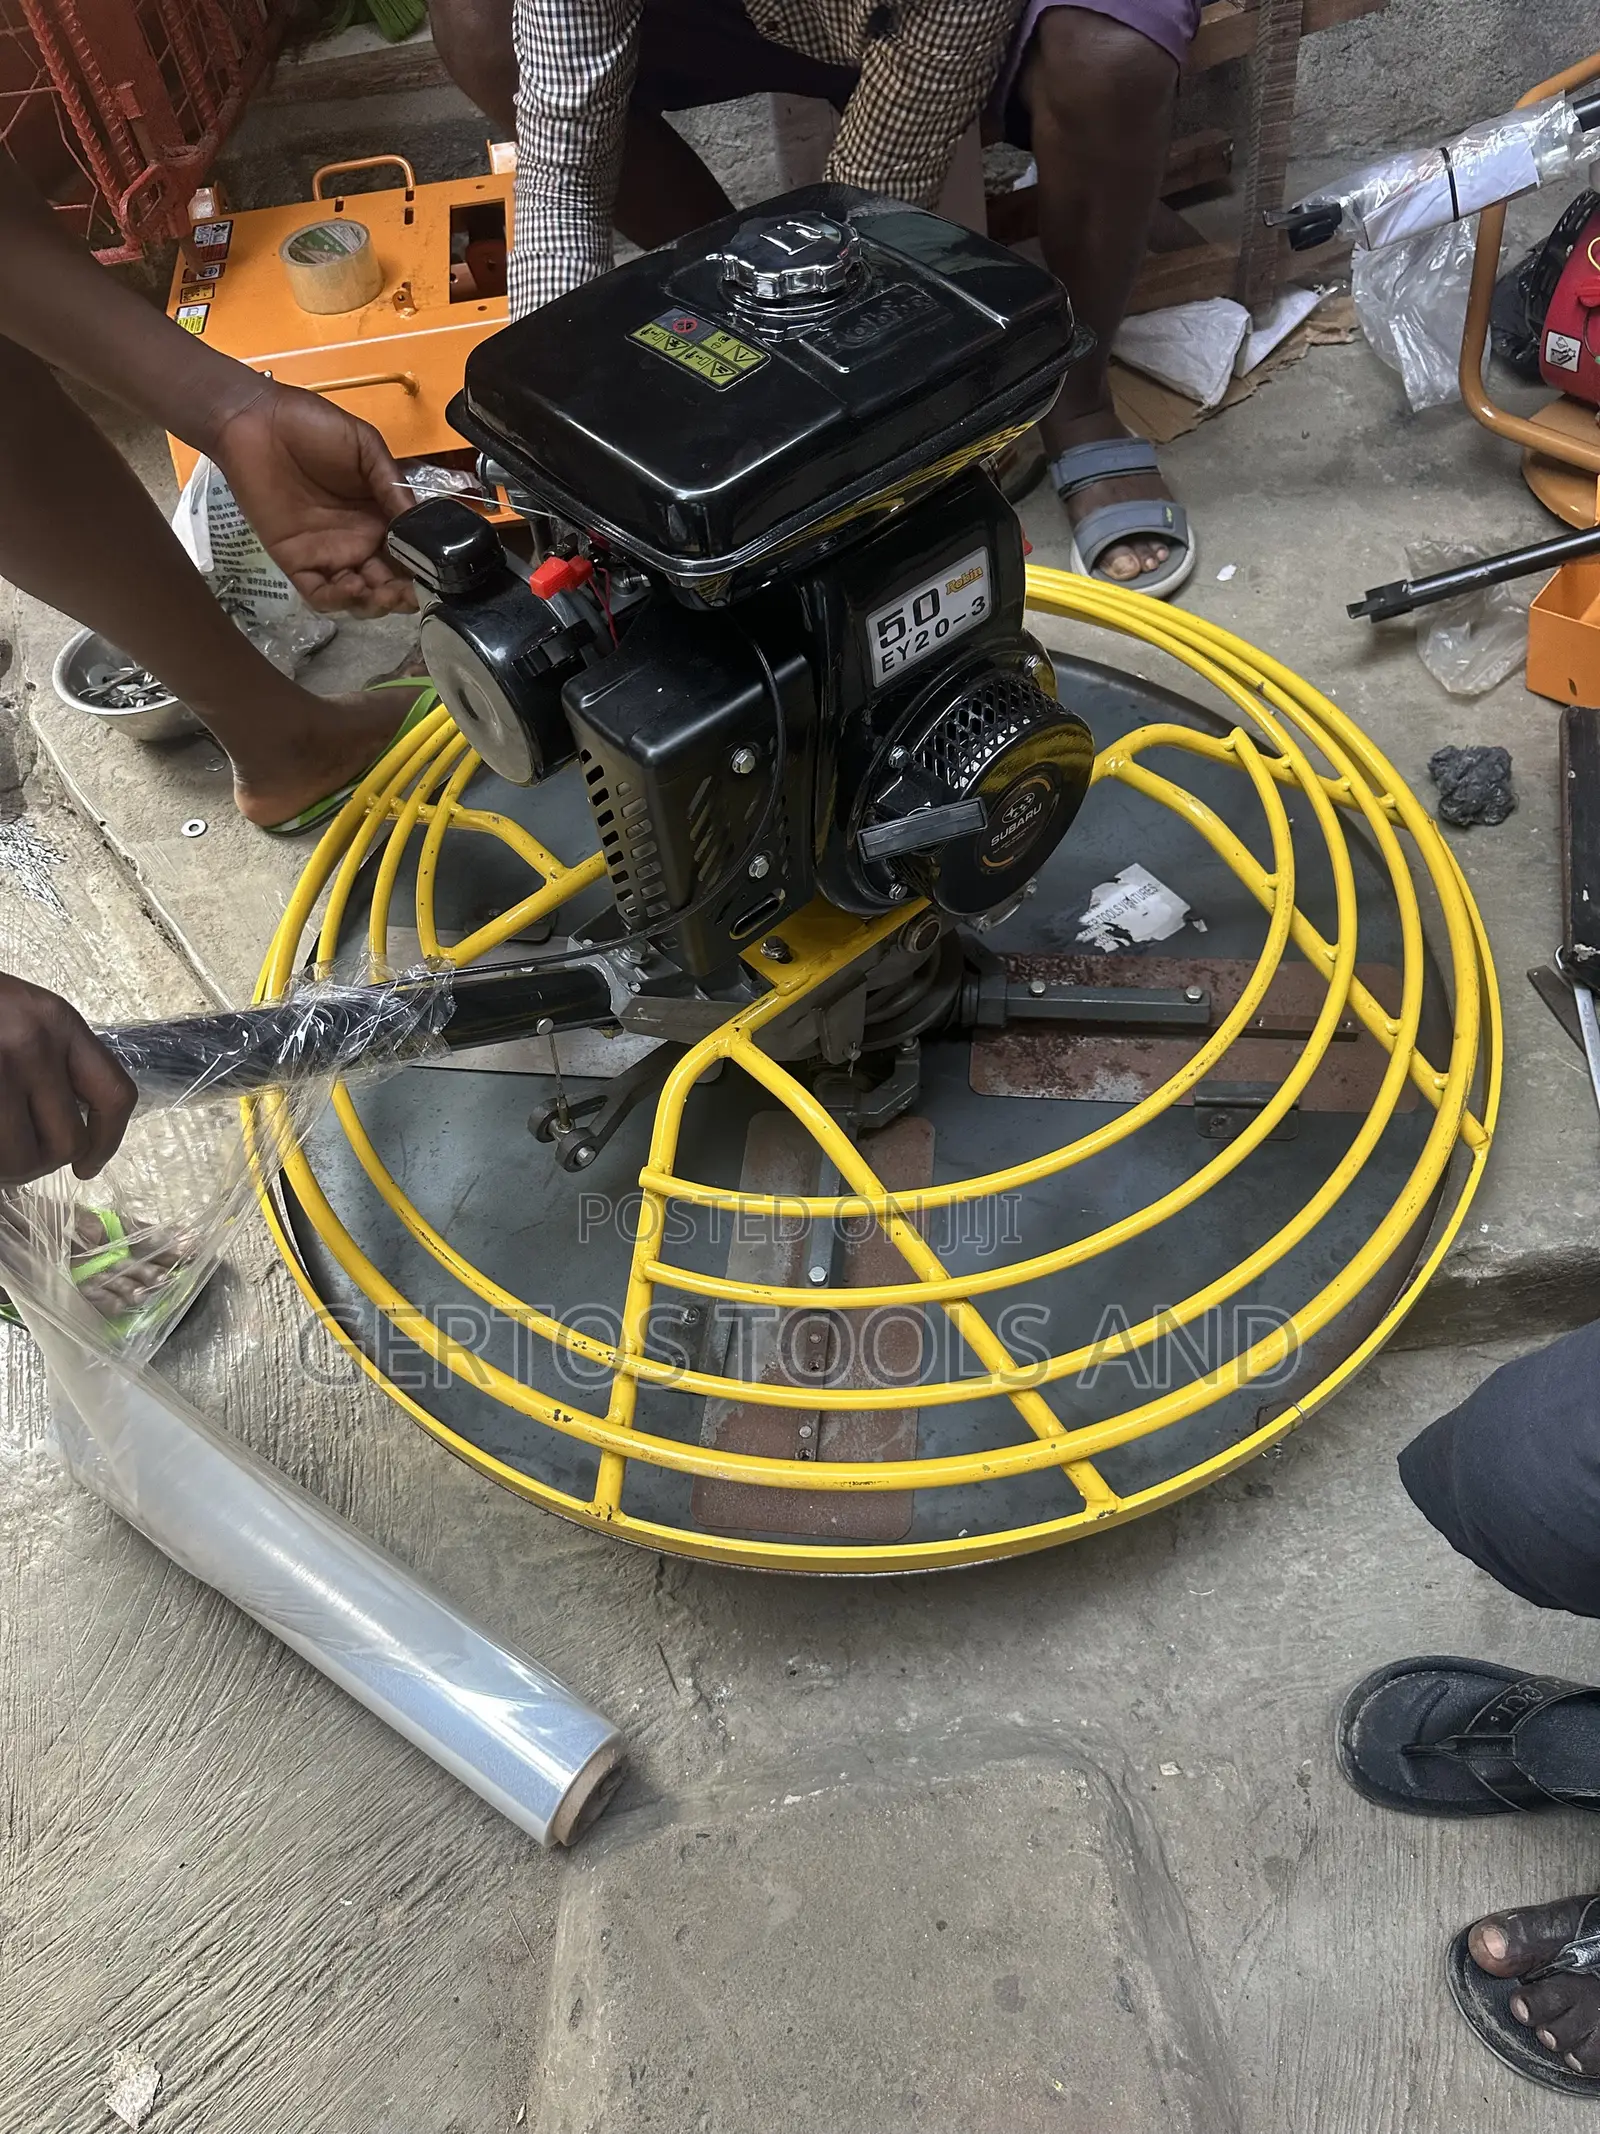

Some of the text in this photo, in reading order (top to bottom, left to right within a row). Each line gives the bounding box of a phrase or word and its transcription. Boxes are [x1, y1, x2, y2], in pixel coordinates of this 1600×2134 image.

[945, 566, 984, 596] Robin
[877, 588, 941, 649] 5.0
[881, 595, 986, 673] EY20-3
[991, 803, 1042, 847] SUBARU
[1095, 903, 1124, 923] TOOLS
